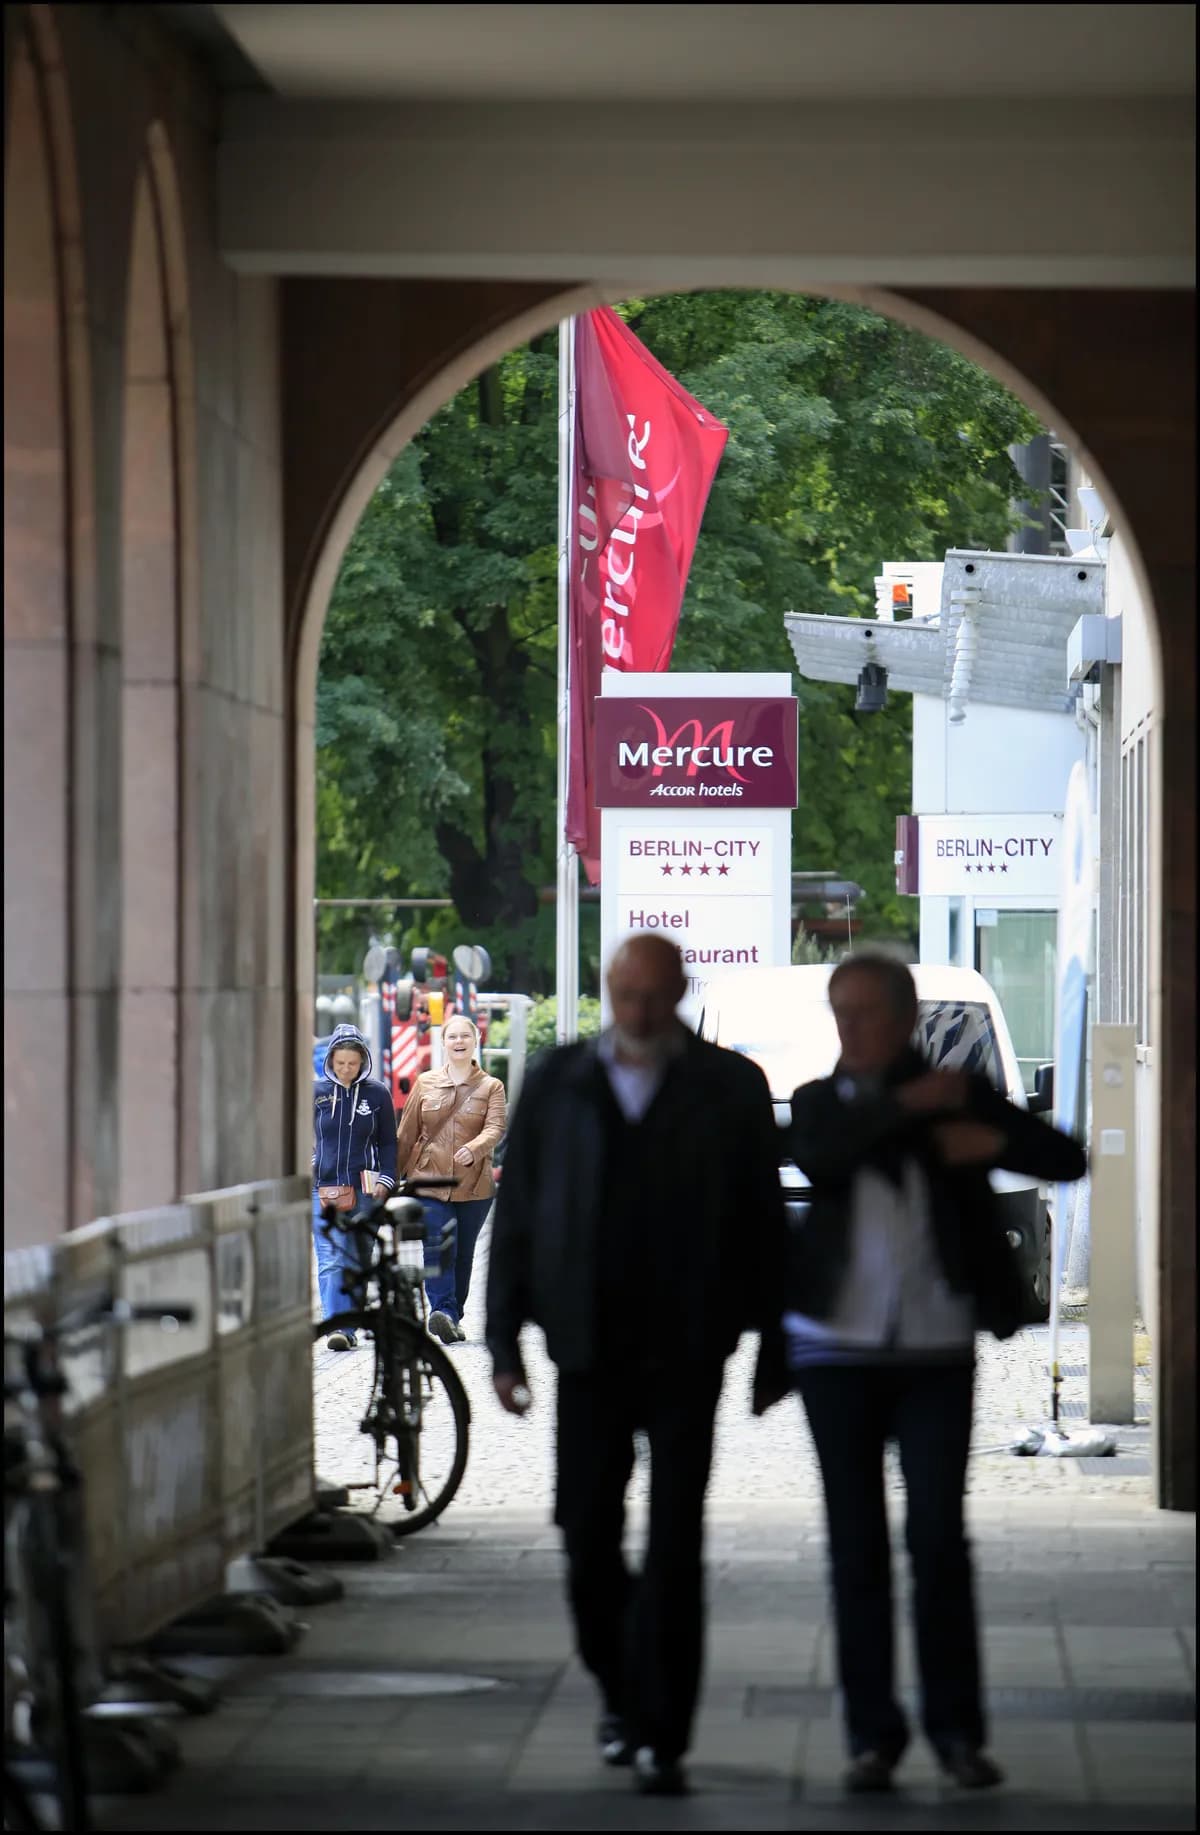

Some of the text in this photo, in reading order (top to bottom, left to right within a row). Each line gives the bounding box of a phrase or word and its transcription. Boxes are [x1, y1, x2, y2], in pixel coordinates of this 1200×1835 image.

[618, 742, 774, 767] Mercure
[698, 782, 744, 797] hotels
[629, 840, 760, 857] BERLIN-CITY
[936, 838, 1054, 857] BERLIN-CITY
[629, 909, 690, 928] Hotel
[677, 945, 759, 964] aurant
